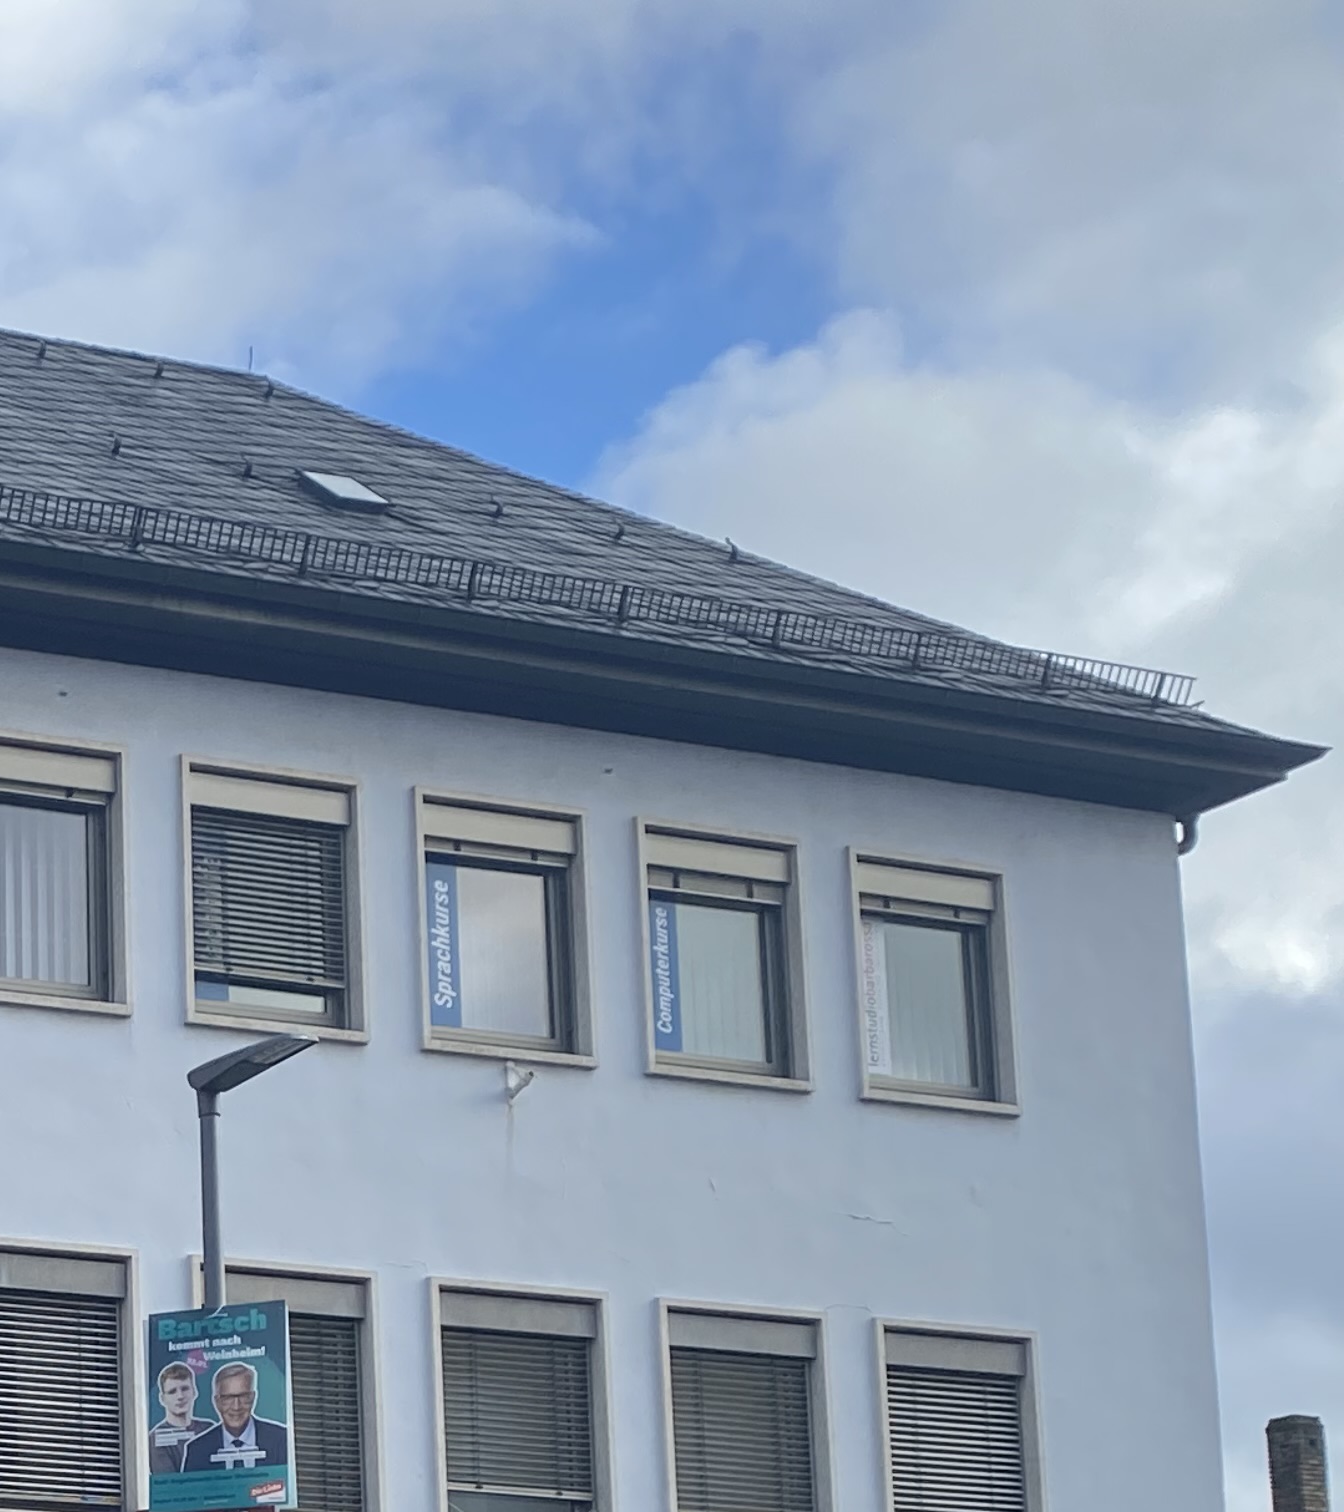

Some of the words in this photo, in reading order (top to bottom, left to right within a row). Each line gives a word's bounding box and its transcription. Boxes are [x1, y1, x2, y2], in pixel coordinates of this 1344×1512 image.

[433, 879, 456, 1009] Sprachkurse
[654, 906, 674, 1035] Computerkurse
[157, 1308, 267, 1340] Bartsch
[168, 1338, 210, 1352] kommt
[212, 1334, 242, 1346] nach
[202, 1345, 266, 1361] Weinheim!
